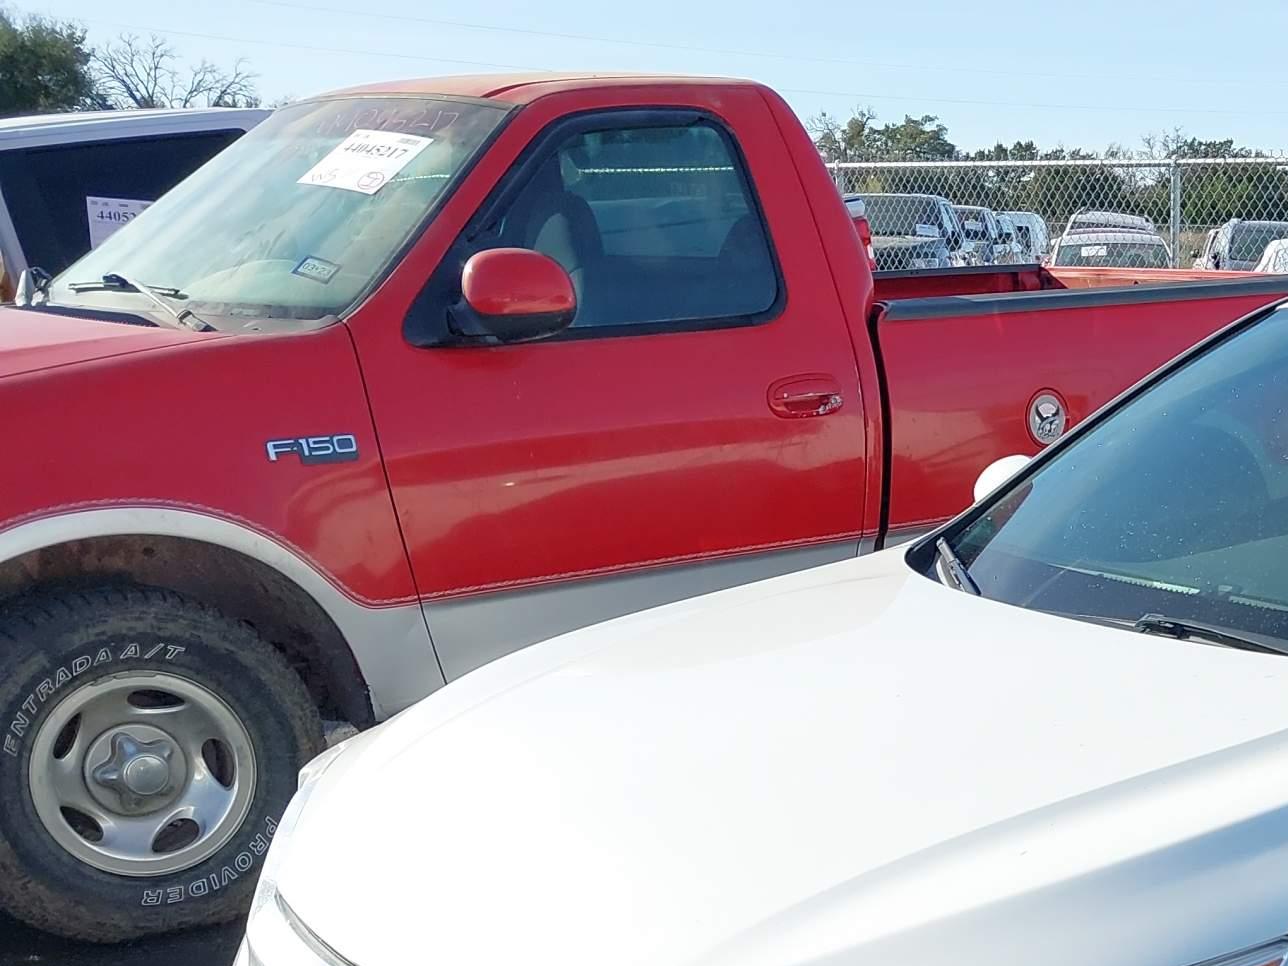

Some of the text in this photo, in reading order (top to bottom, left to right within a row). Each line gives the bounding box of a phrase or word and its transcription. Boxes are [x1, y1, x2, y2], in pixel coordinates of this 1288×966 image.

[344, 142, 409, 160] 44045217
[3, 642, 186, 757] ENTRADA A/T
[141, 816, 278, 906] PROVIDER
